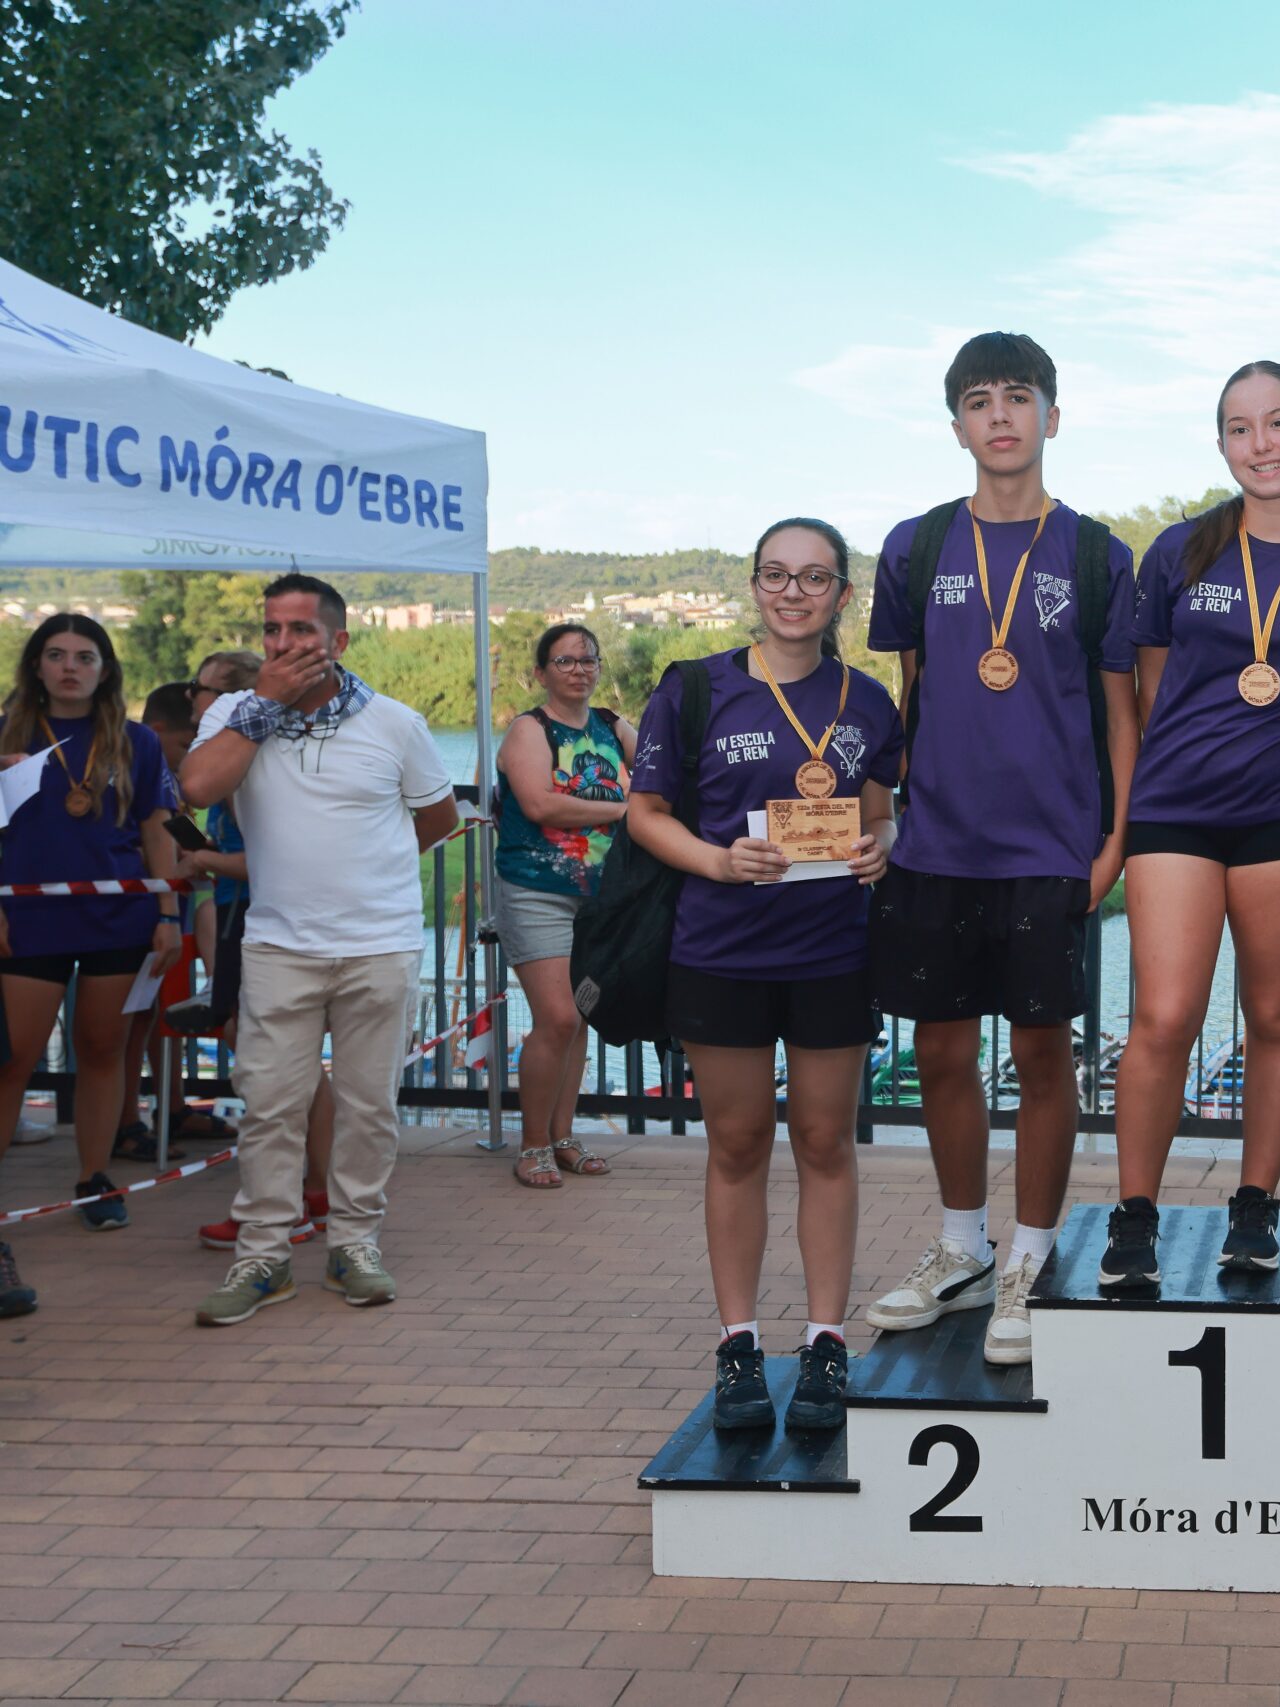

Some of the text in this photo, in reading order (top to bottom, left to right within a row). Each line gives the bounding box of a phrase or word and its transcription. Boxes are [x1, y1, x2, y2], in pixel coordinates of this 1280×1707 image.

[159, 425, 301, 511] MÓRA
[315, 464, 464, 531] D'EBRE
[935, 574, 974, 590] ESCOLA
[1198, 582, 1242, 601] ESCOLA
[944, 590, 966, 605] REM
[1190, 597, 1231, 614] DE REM
[716, 731, 776, 753] IV ESCOLA
[727, 746, 769, 765] DE REM
[1167, 1326, 1226, 1460] 1
[907, 1424, 984, 1533] 2
[1081, 1497, 1200, 1533] Móra
